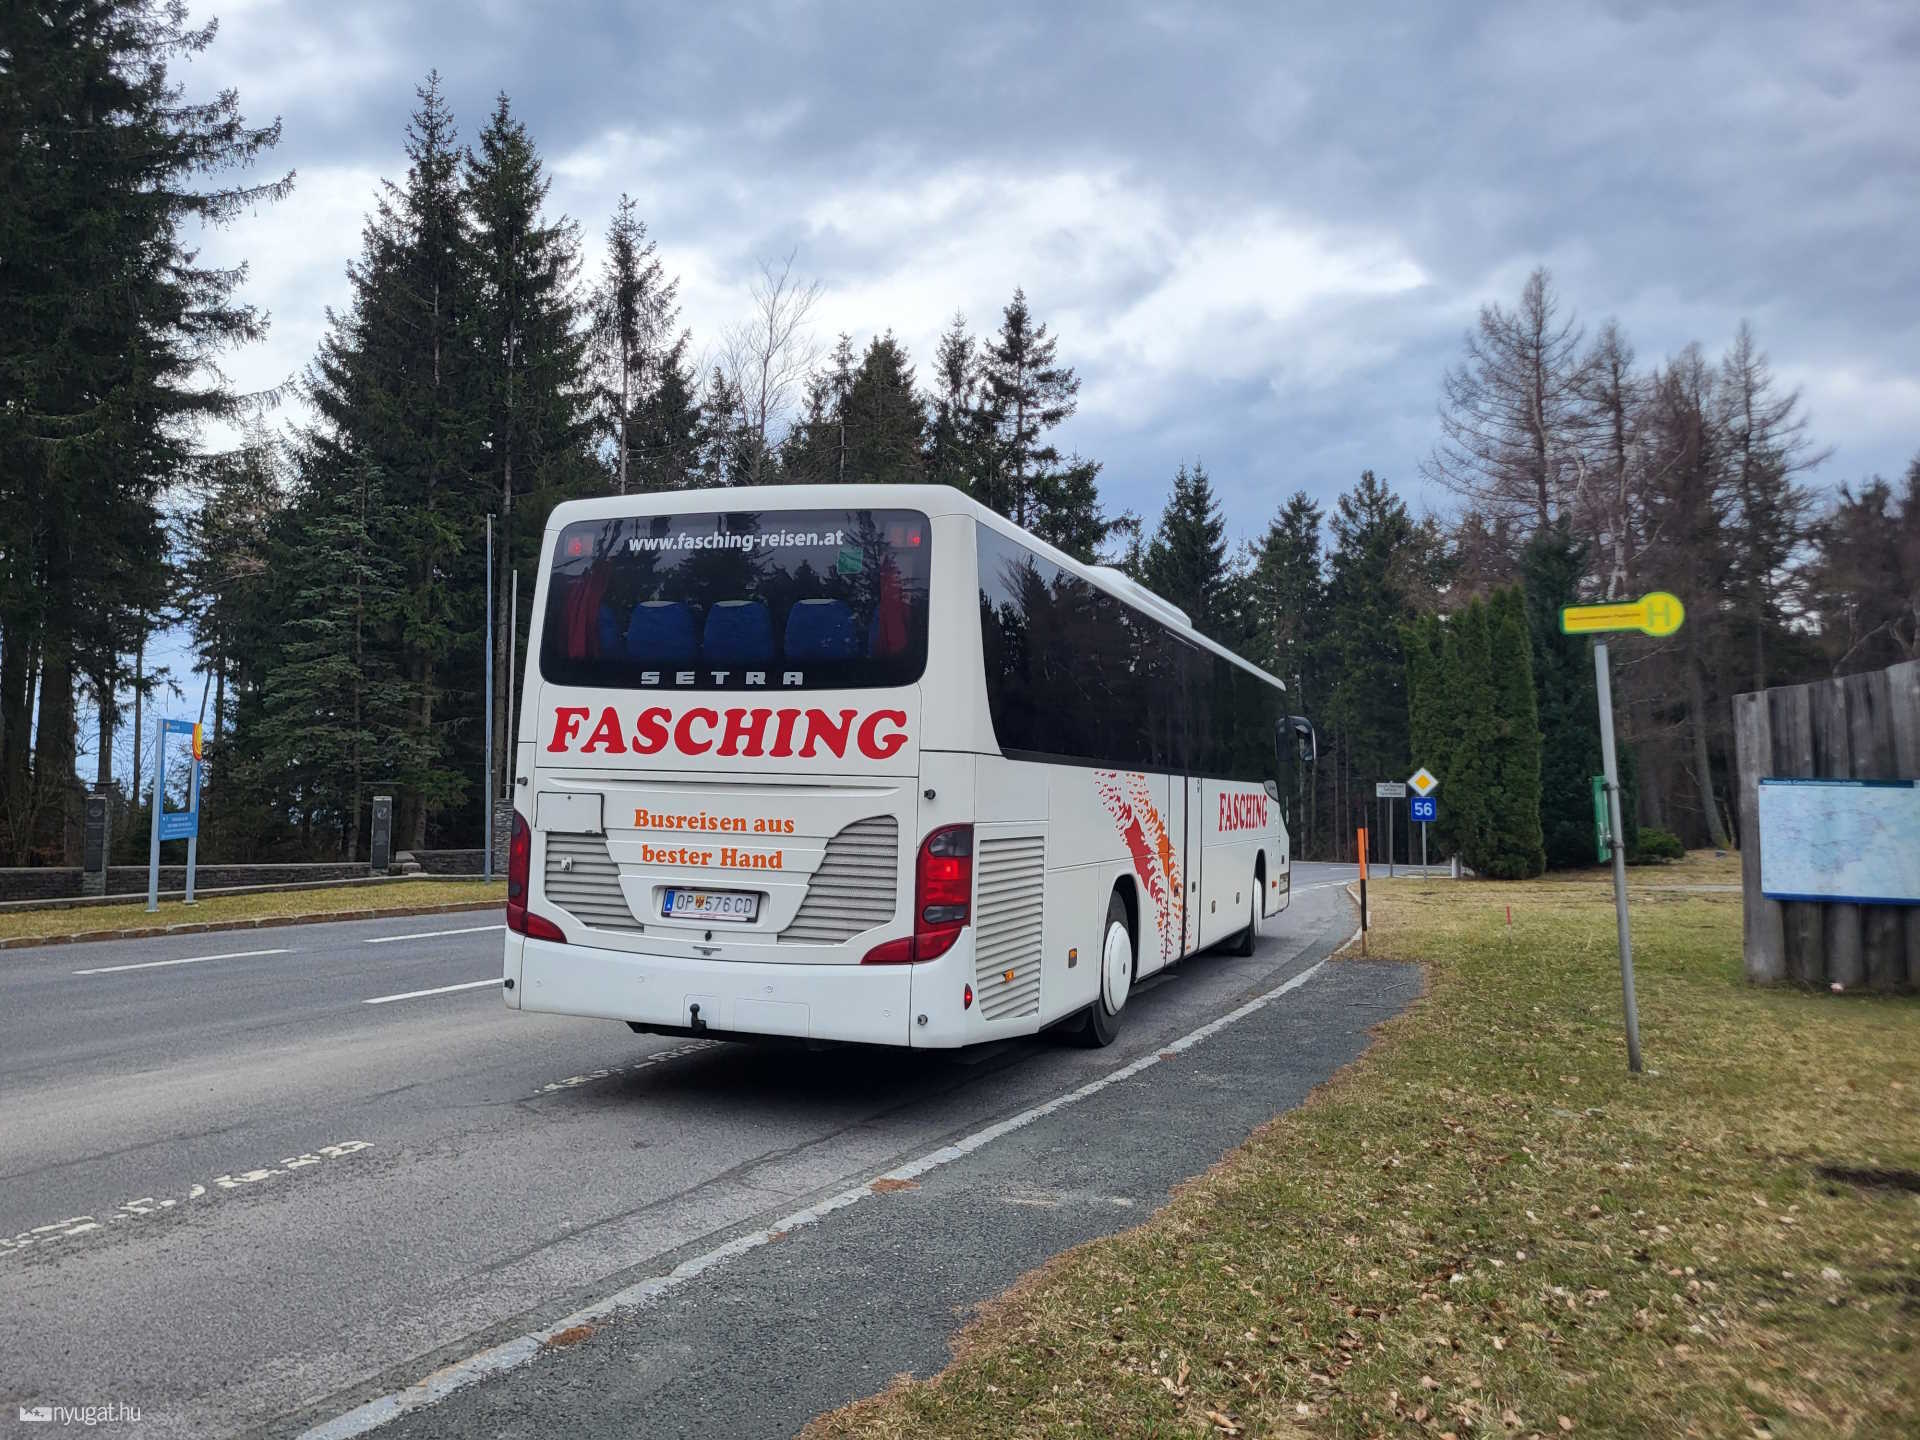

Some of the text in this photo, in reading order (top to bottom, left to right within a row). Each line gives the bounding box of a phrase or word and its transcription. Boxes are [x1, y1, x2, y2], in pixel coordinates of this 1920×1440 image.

[628, 529, 844, 553] www.fasching-reisen.at
[640, 671, 804, 686] SETRA
[546, 706, 909, 760] FASCHING
[633, 808, 795, 833] Busreisen aus
[1218, 792, 1268, 832] FASCHING
[1414, 802, 1433, 816] 56
[642, 844, 783, 869] bester Hand
[676, 894, 694, 911] OP
[704, 895, 732, 913] 576
[734, 897, 753, 914] CD
